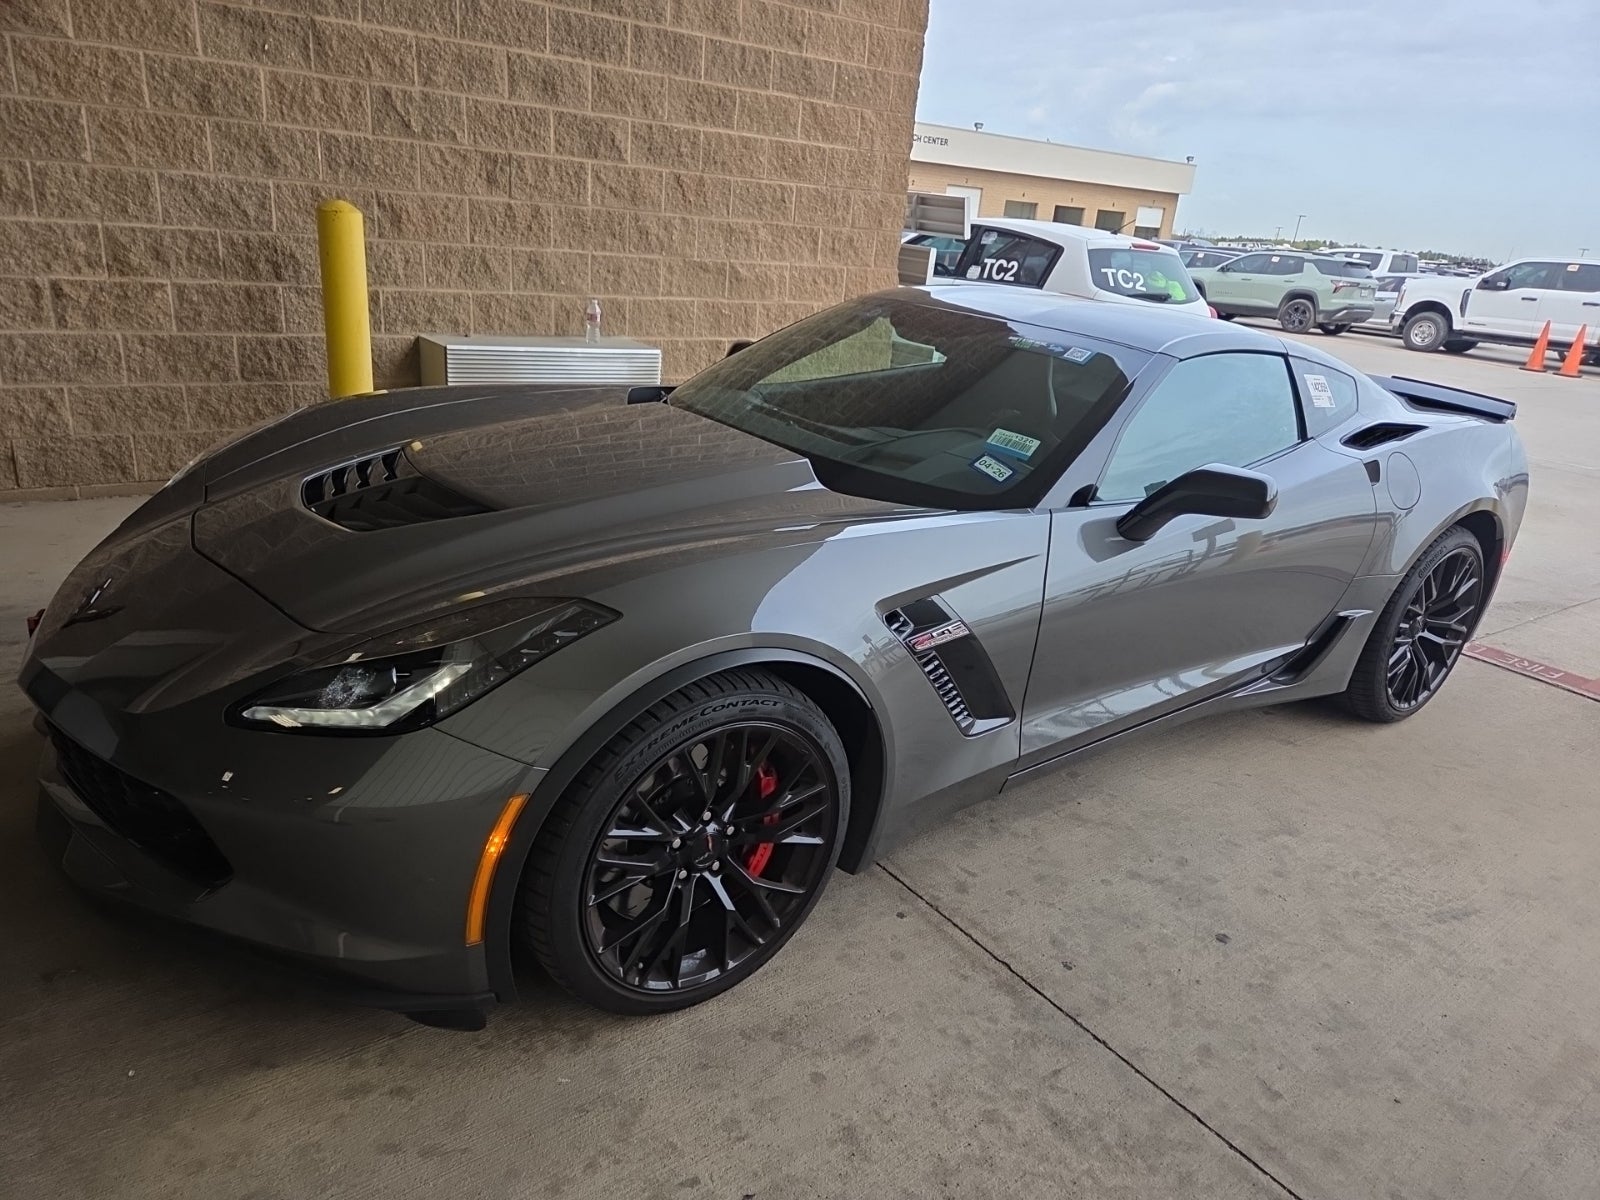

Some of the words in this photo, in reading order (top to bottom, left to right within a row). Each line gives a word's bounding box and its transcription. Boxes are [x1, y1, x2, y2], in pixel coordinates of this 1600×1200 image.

[923, 135, 949, 146] CENTER
[982, 258, 1019, 282] TC2
[1101, 268, 1147, 292] TC2
[1496, 652, 1565, 679] FIRE
